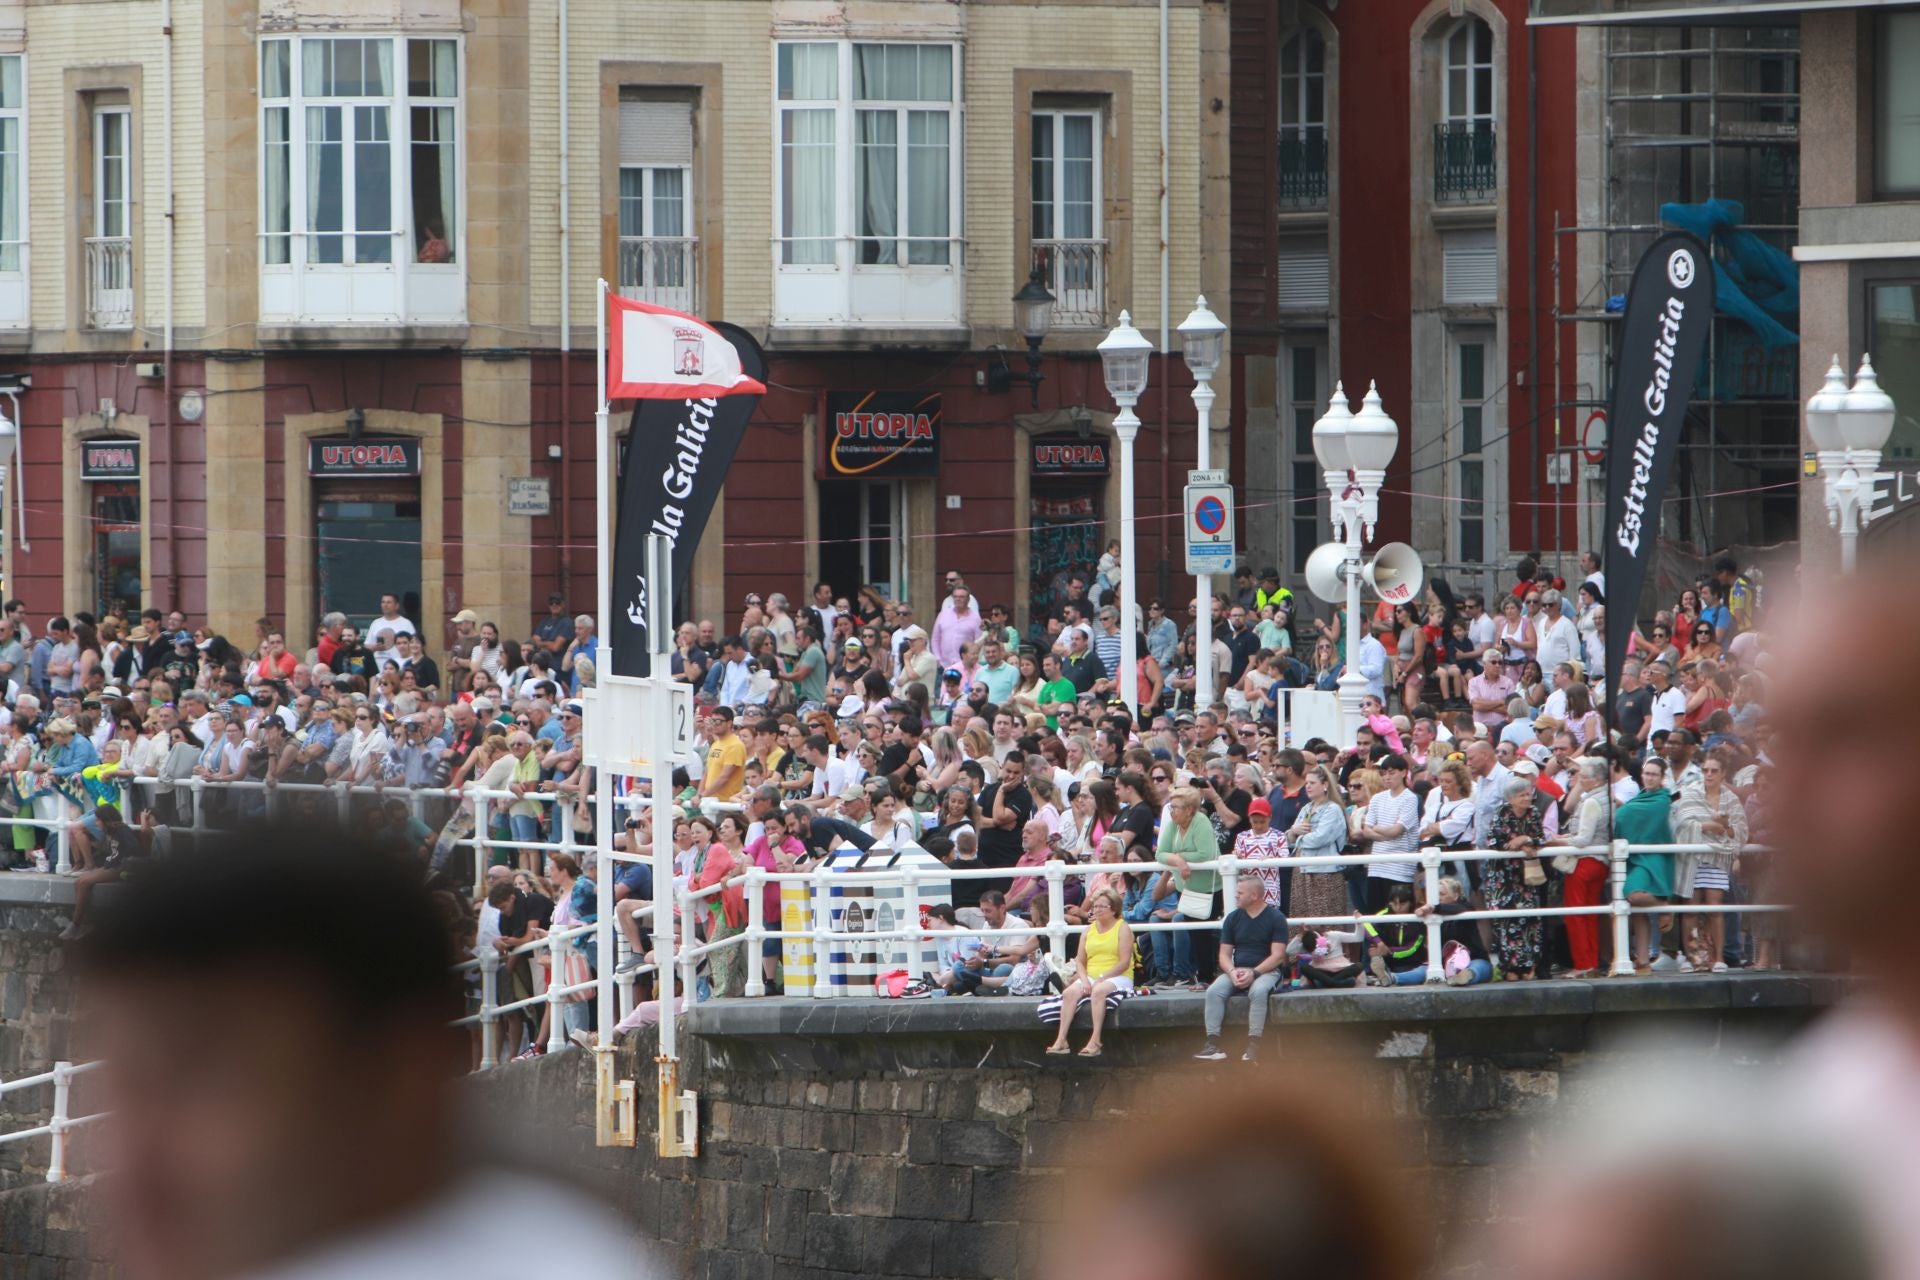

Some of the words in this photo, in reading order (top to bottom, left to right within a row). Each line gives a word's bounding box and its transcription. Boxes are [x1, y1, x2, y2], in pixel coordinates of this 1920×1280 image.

[836, 412, 934, 440] UTOPIA
[1616, 421, 1660, 558] Estrella
[1645, 296, 1685, 417] Galicia
[87, 448, 135, 467] UTOPIA
[322, 445, 407, 464] UTOPIA
[1034, 445, 1105, 464] UTOPIA
[1192, 474, 1211, 482] ZONA
[678, 704, 686, 741] 2
